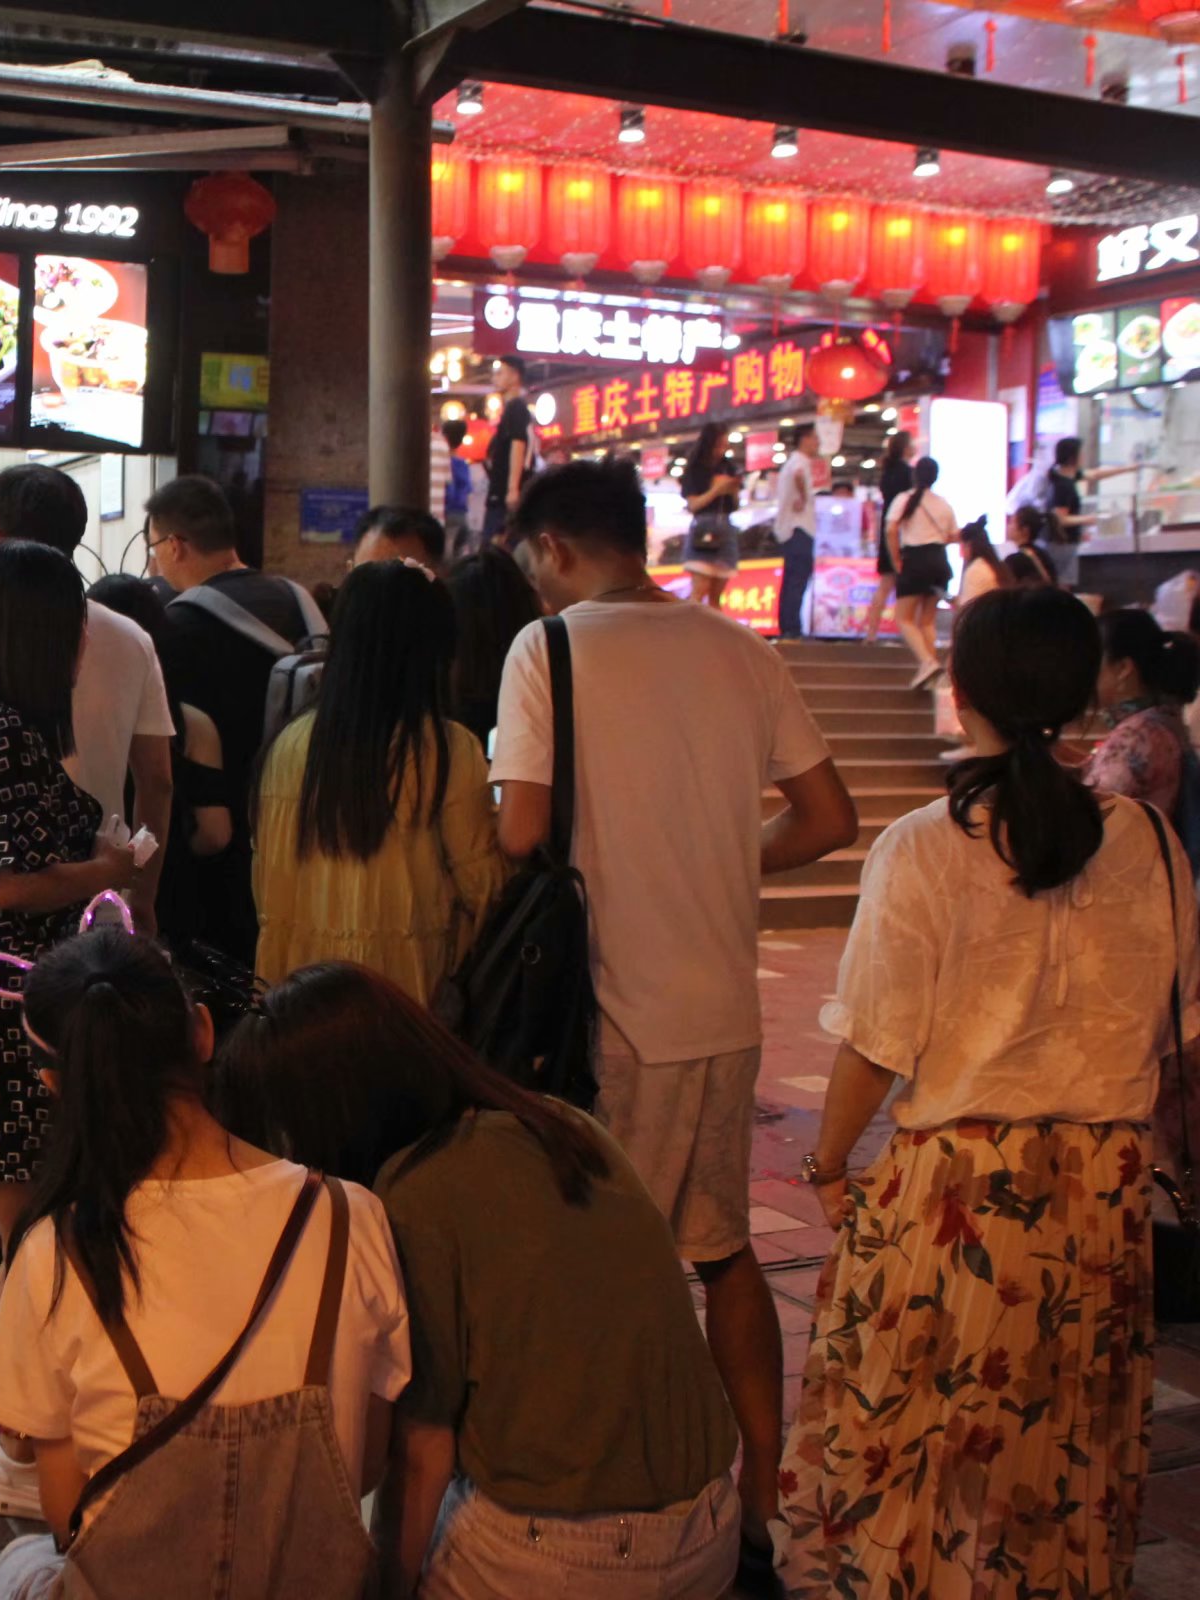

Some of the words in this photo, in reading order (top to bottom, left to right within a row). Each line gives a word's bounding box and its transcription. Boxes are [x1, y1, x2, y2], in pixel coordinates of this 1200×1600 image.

[61, 202, 140, 239] 1992
[1096, 213, 1200, 282] 好又
[516, 301, 722, 365] 重庆土特产
